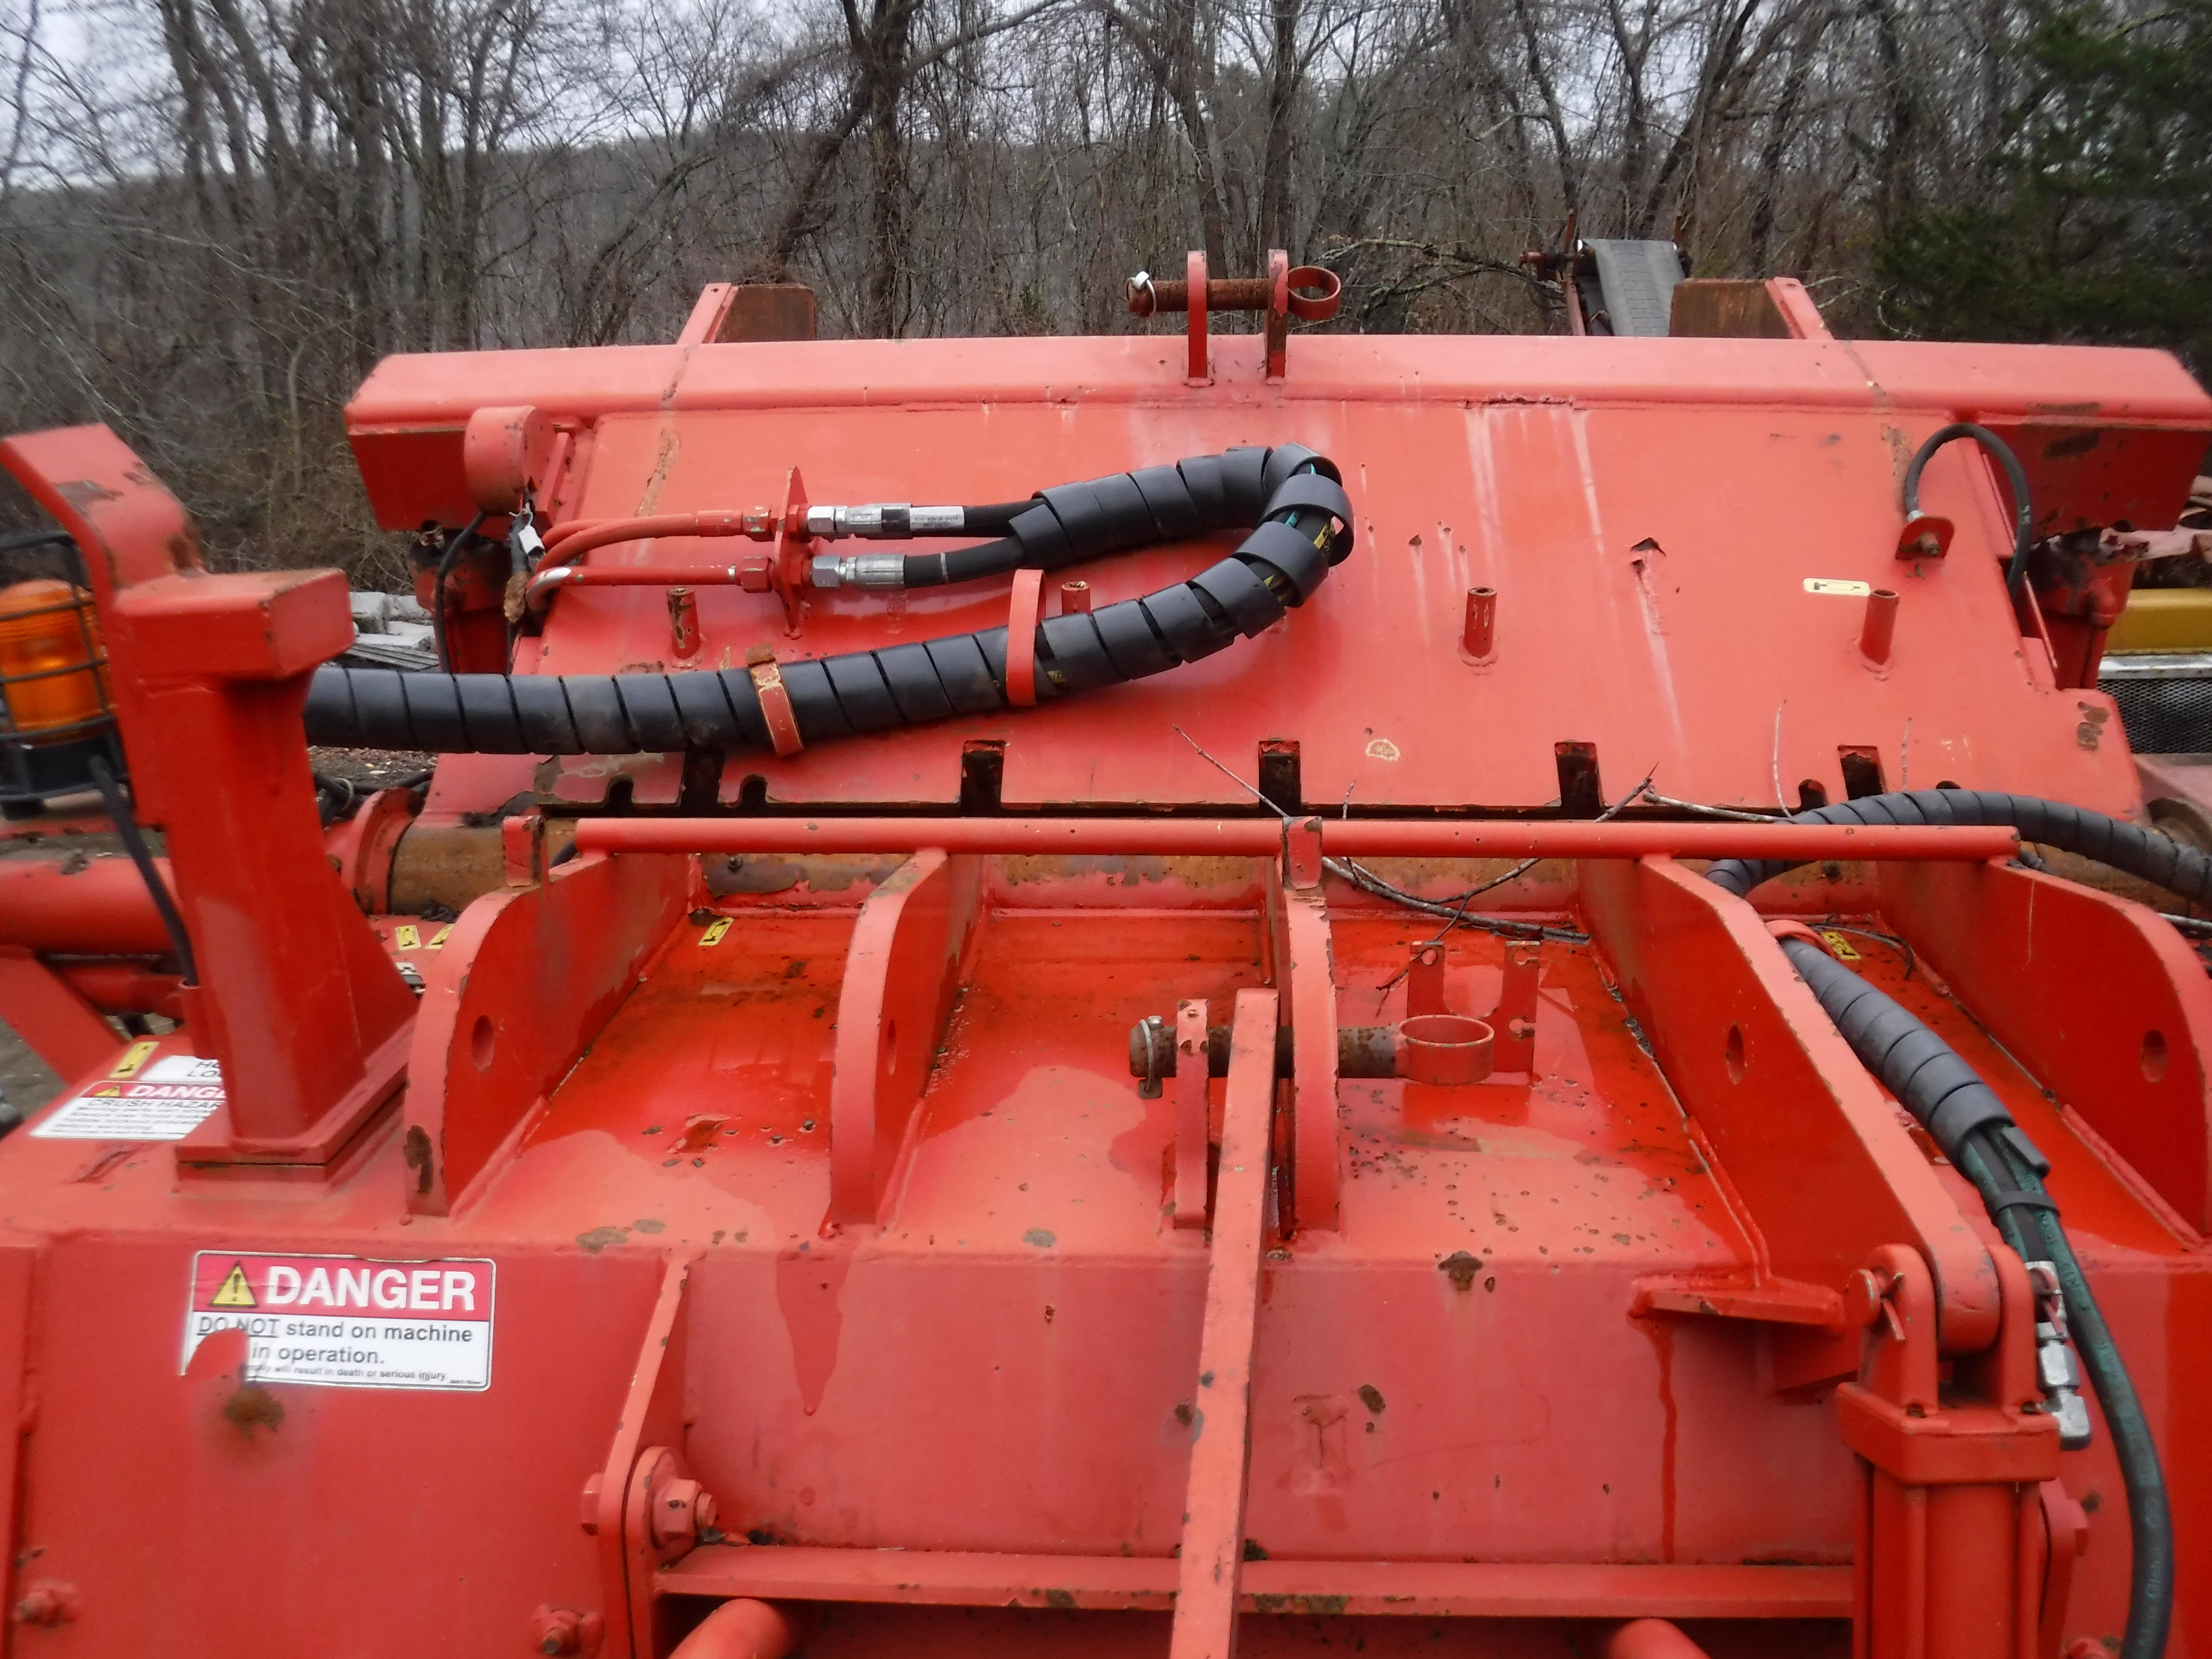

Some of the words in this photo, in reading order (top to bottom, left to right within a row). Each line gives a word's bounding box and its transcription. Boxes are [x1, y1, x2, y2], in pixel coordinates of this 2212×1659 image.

[265, 1265, 475, 1311] DANGER
[199, 1316, 228, 1333] DO
[287, 1321, 344, 1338] stand
[351, 1325, 376, 1338] on
[385, 1324, 472, 1342] machine
[252, 1343, 270, 1358] in
[278, 1346, 385, 1364] operation.
[380, 1370, 415, 1379] serious
[419, 1370, 446, 1381] injury
